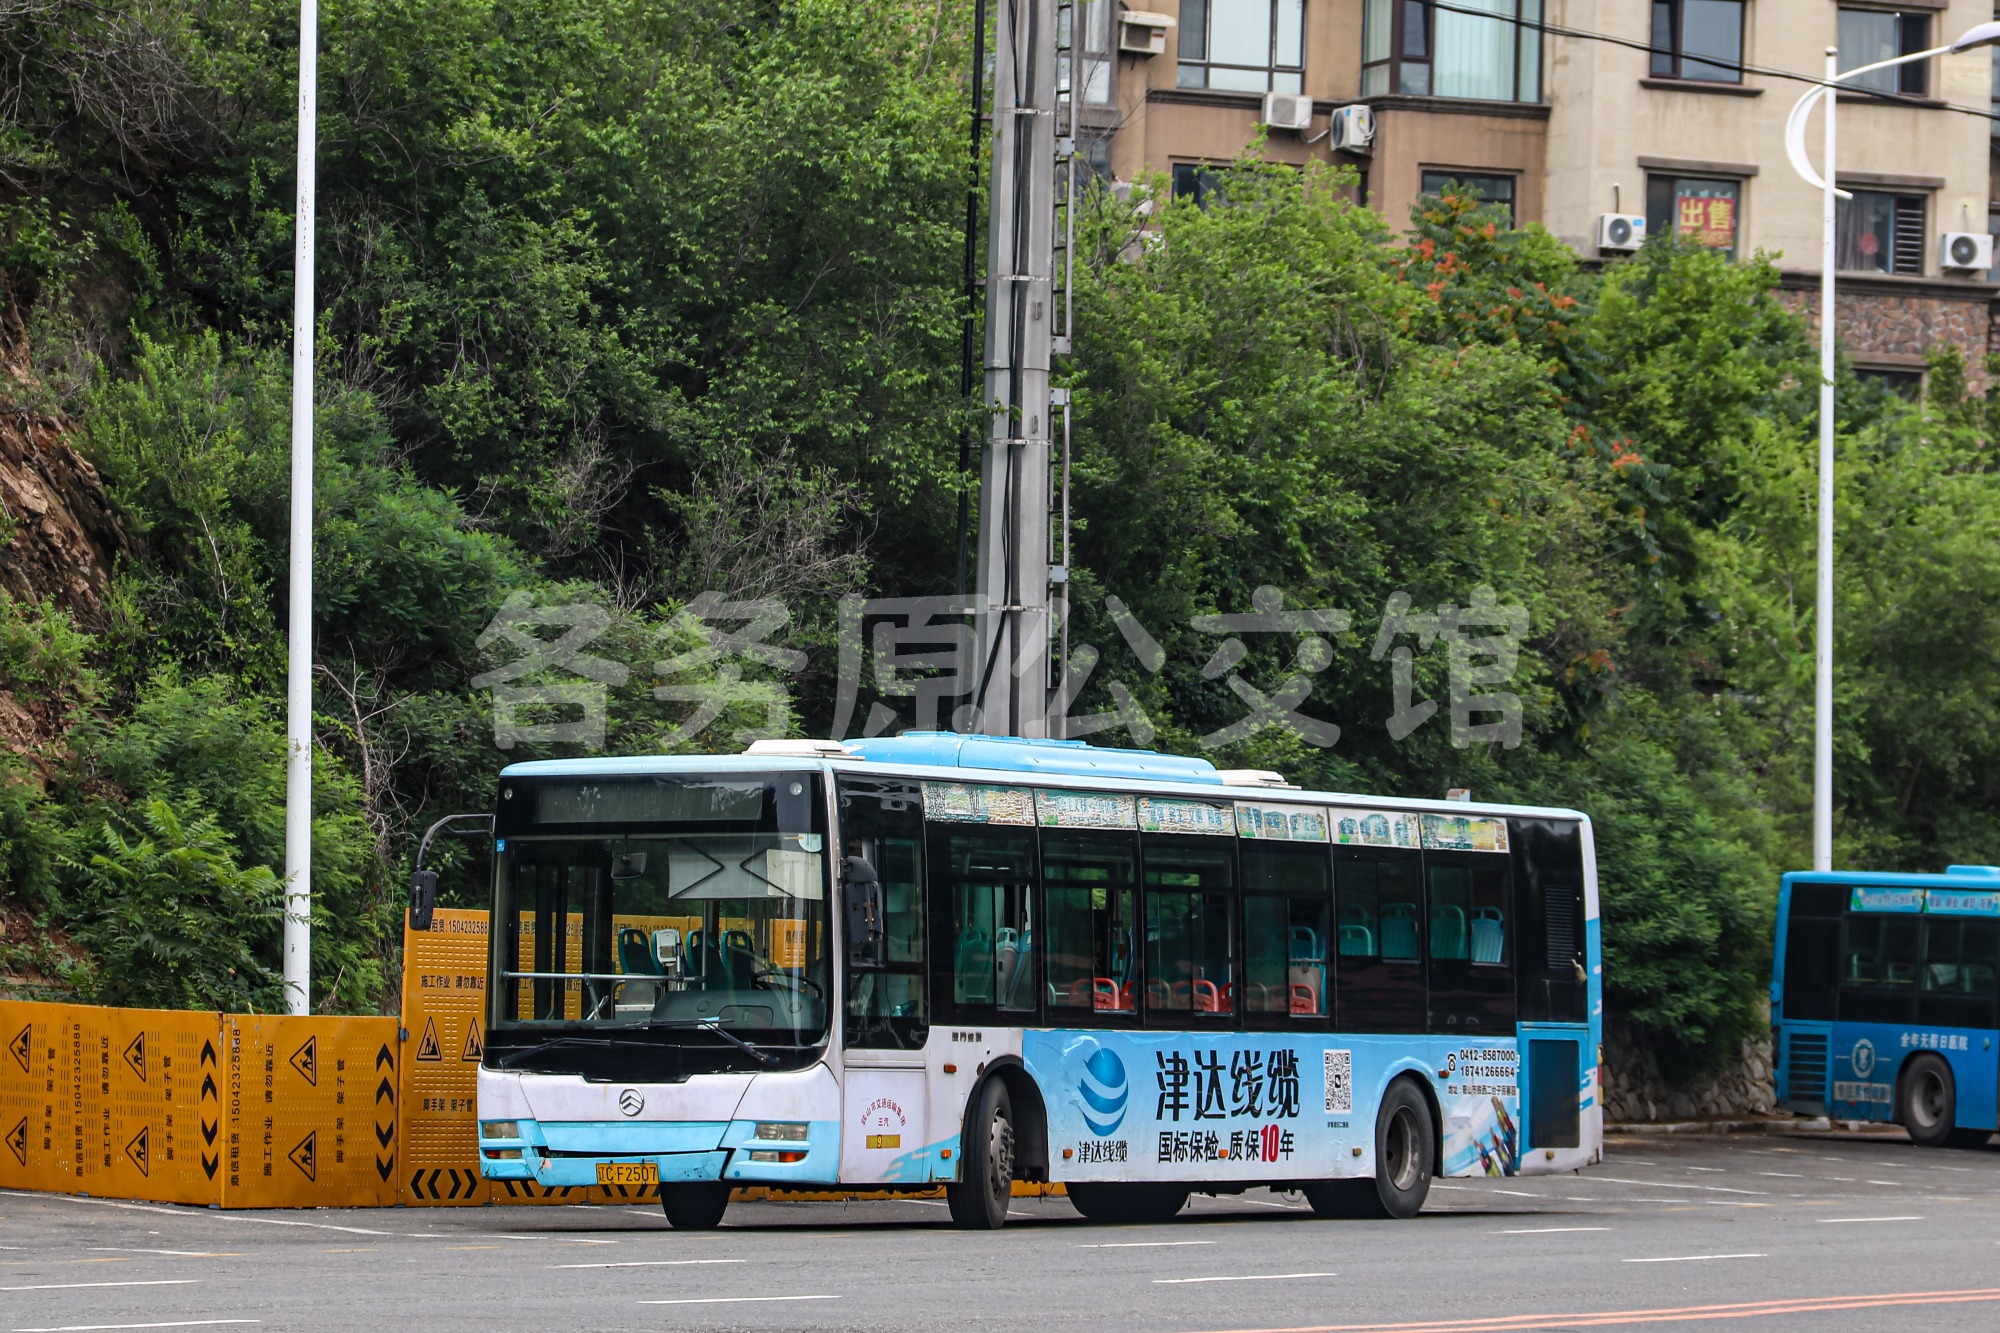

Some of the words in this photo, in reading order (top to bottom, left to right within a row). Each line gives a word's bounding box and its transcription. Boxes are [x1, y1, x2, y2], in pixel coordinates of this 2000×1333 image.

[1680, 199, 1732, 230] 出售
[421, 974, 451, 989] 施工作业
[456, 975, 485, 990] 请勿靠近
[1459, 1049, 1516, 1061] 0412-8587000
[1901, 1032, 1969, 1051] 全年无假日医院
[46, 1046, 56, 1093] 架子管
[100, 1035, 110, 1096] 请勿靠近
[162, 1054, 172, 1102] 架子管
[264, 1042, 274, 1104] 请勿靠近
[335, 1058, 345, 1105] 架子管
[1155, 1048, 1301, 1122] 津达线缆
[1460, 1065, 1515, 1078] 18741266664
[73, 1023, 84, 1178] 鼎信租赁:15042325888
[422, 1098, 446, 1112] 脚手架
[450, 1098, 474, 1113] 架子管
[877, 1116, 890, 1127] 三汽
[43, 1104, 53, 1151] 脚手架
[102, 1107, 112, 1168] 施工作业
[164, 1113, 174, 1161] 脚手架
[263, 1116, 273, 1177] 施工作业
[335, 1116, 345, 1164] 脚手架
[1157, 1130, 1220, 1164] 国标保检
[1227, 1124, 1295, 1164] 质保10年
[1077, 1140, 1128, 1165] 津达线缆
